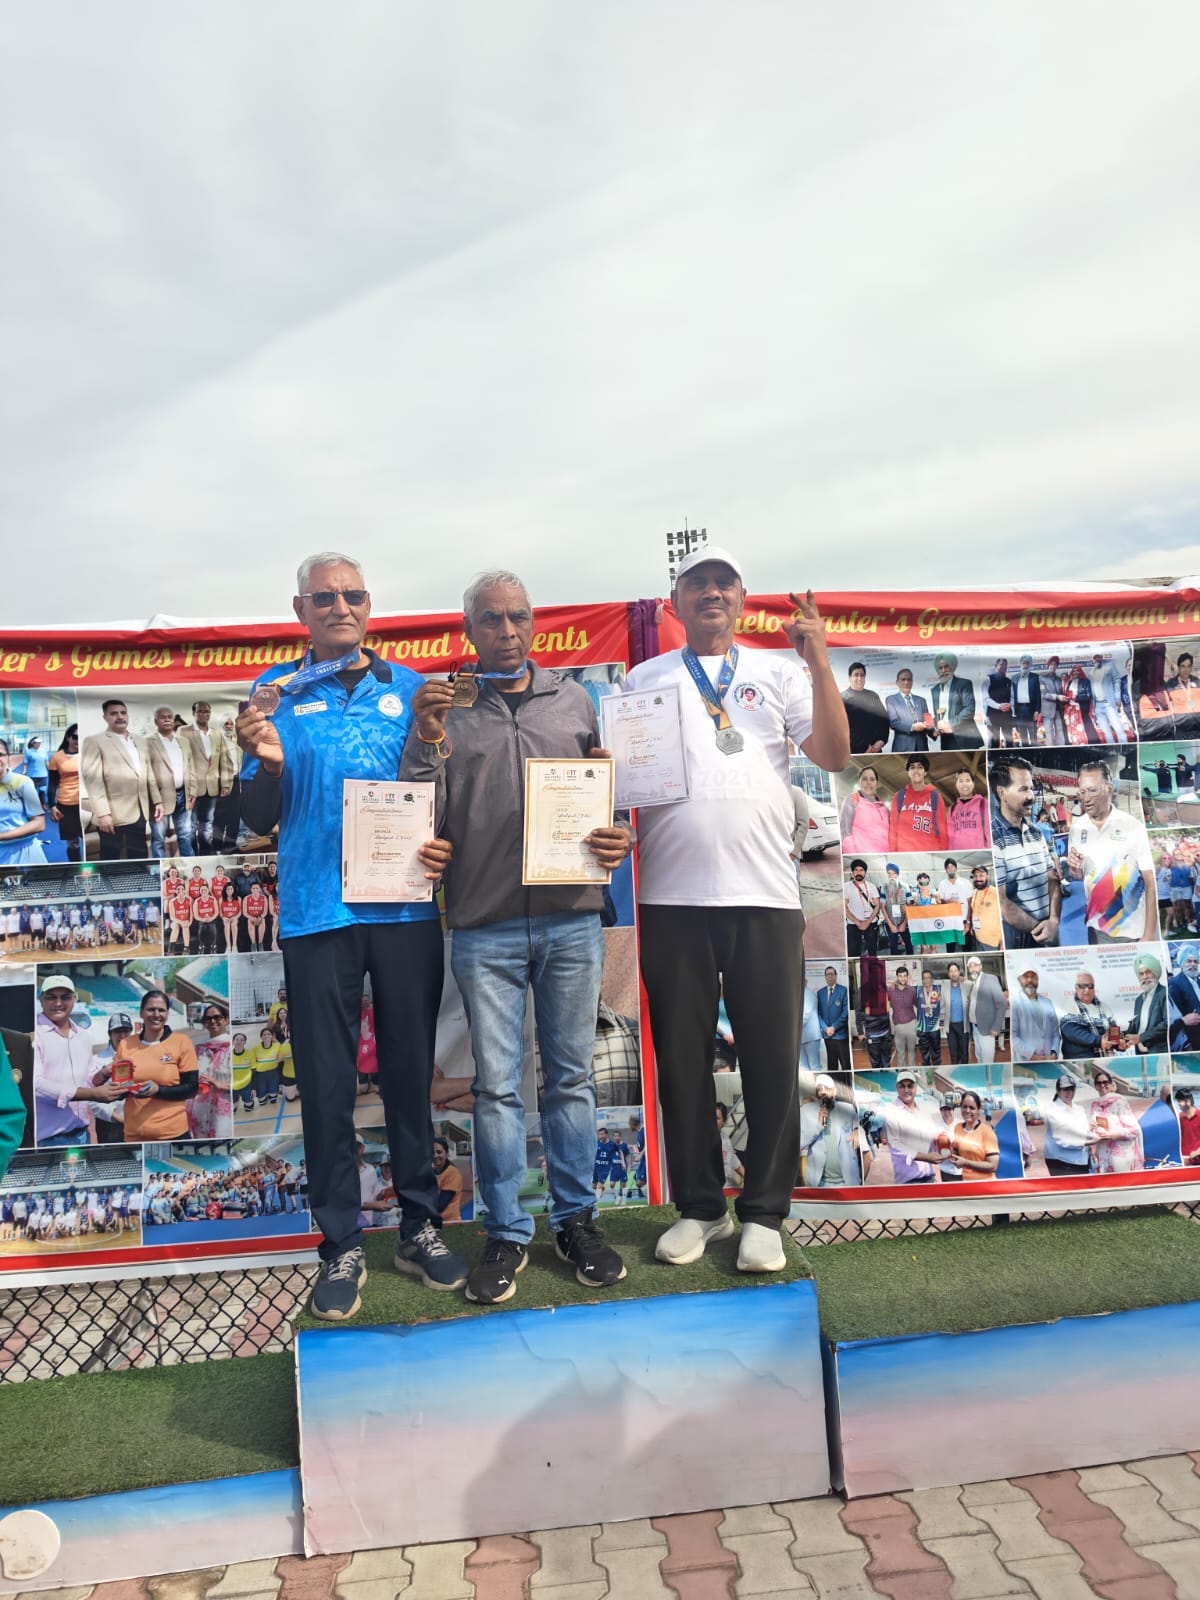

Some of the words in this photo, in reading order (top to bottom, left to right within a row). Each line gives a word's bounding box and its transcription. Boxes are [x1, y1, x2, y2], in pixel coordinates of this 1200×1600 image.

[734, 609, 785, 634] elo
[790, 607, 909, 634] aster's
[917, 607, 1009, 639] Games
[71, 644, 173, 678] Games
[180, 640, 304, 667] Foundat
[359, 631, 453, 660] Proud
[460, 626, 590, 656] Ments
[912, 816, 931, 833] 32
